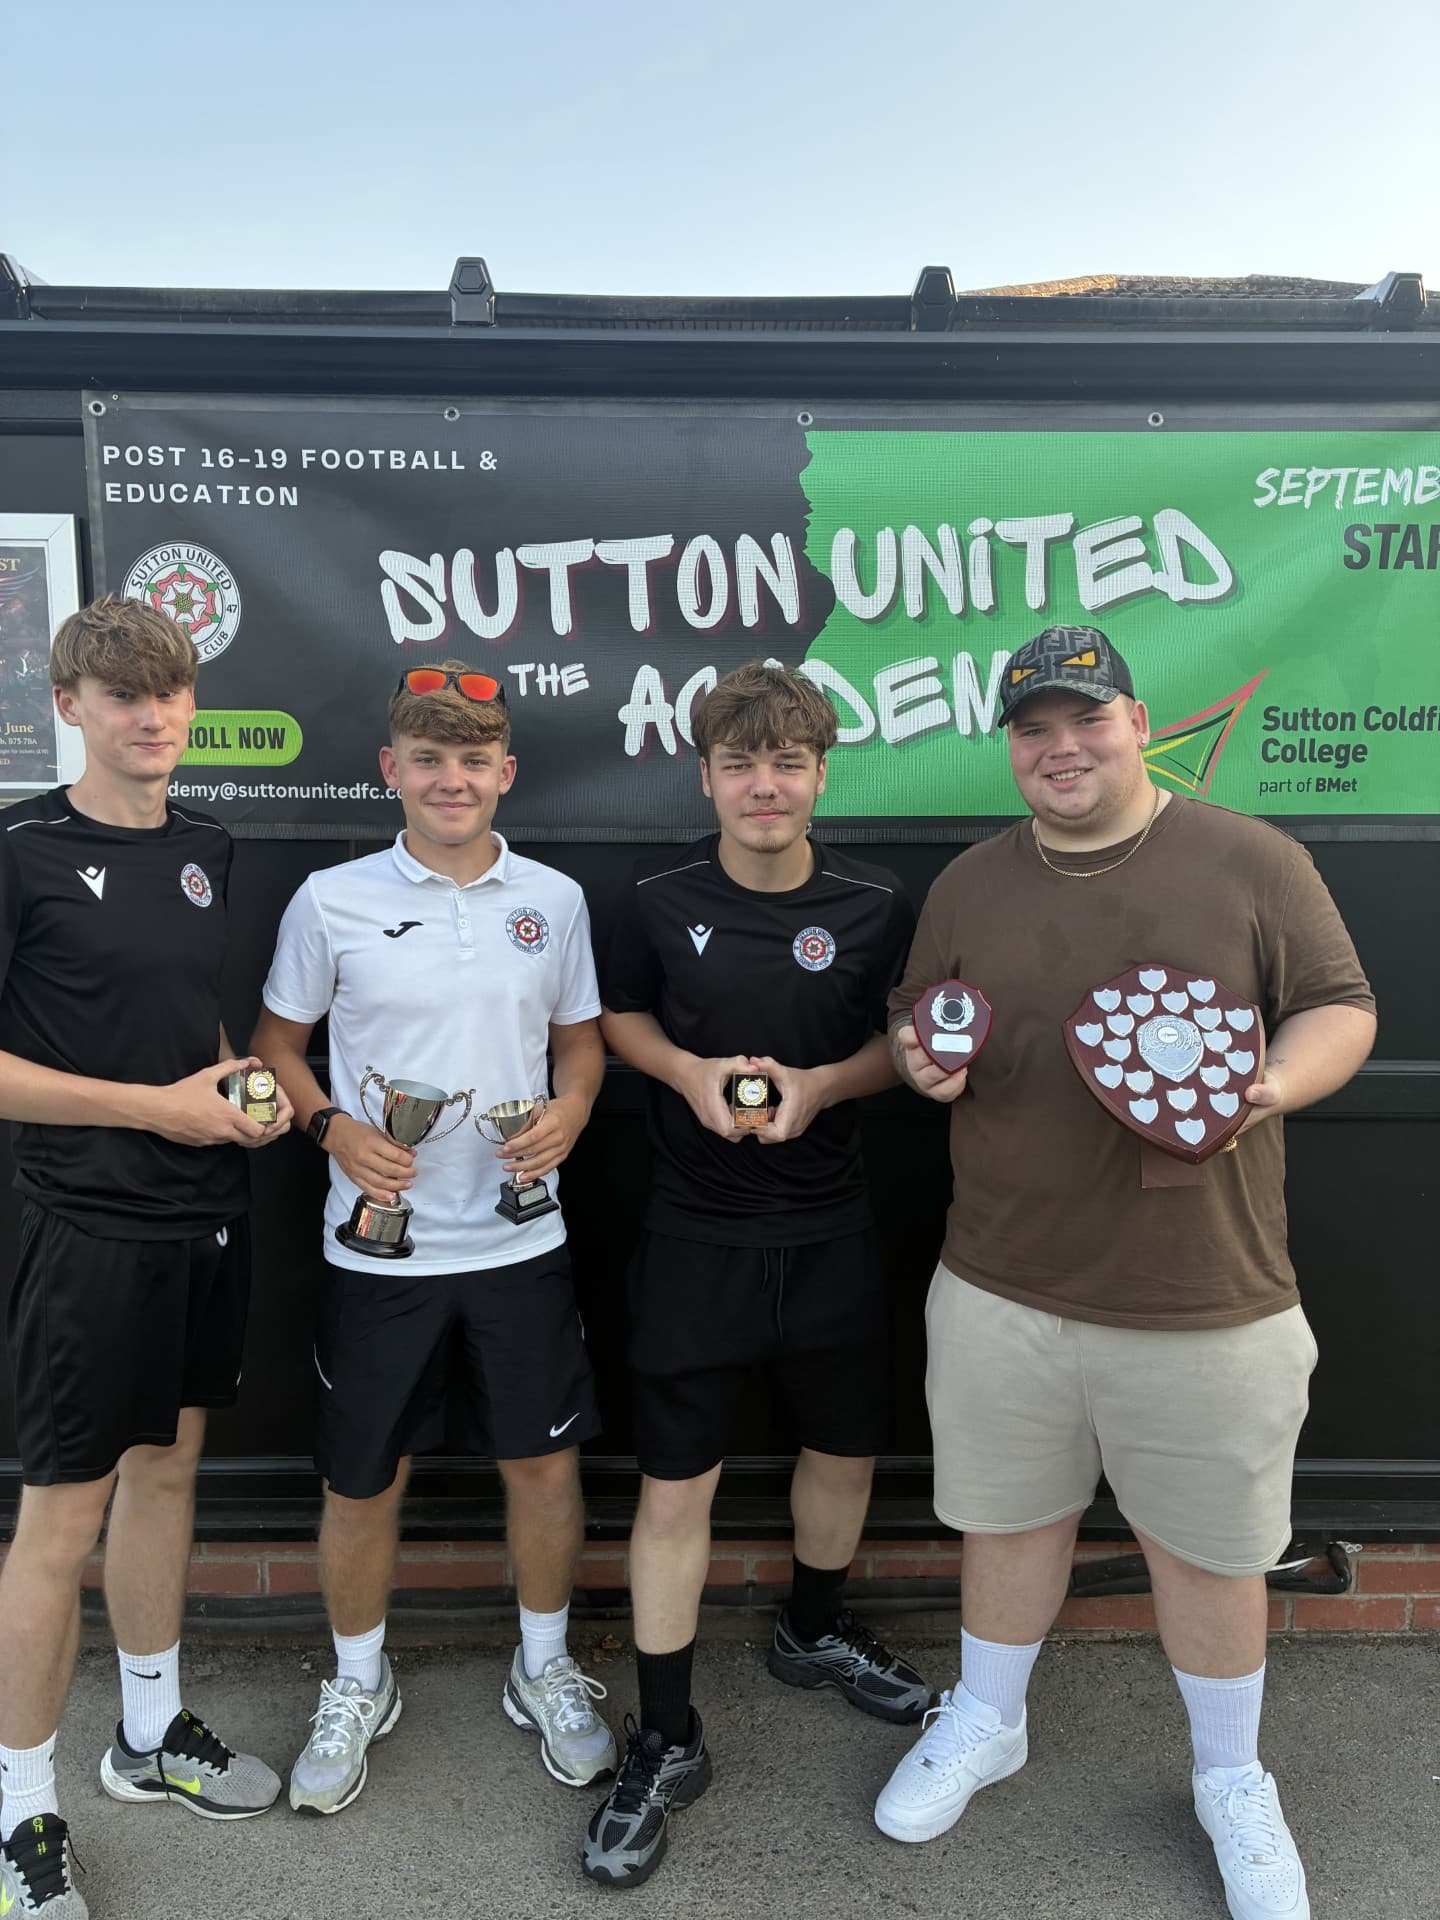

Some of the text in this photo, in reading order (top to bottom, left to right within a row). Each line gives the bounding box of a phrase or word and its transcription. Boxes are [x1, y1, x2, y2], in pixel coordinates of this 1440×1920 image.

[103, 445, 498, 470] POST 16-19 FOOTBALL &
[105, 482, 298, 506] EDUCATION
[131, 548, 232, 590] SUTTON UNITED
[379, 533, 800, 643] SUTTON
[226, 604, 237, 613] 47
[204, 631, 229, 655] CLUB
[507, 663, 590, 696] THE
[5, 722, 34, 735] June
[1262, 705, 1356, 732] Sutton
[238, 726, 286, 750] NOW
[1261, 737, 1368, 769] College
[1259, 777, 1358, 796] part of BMet
